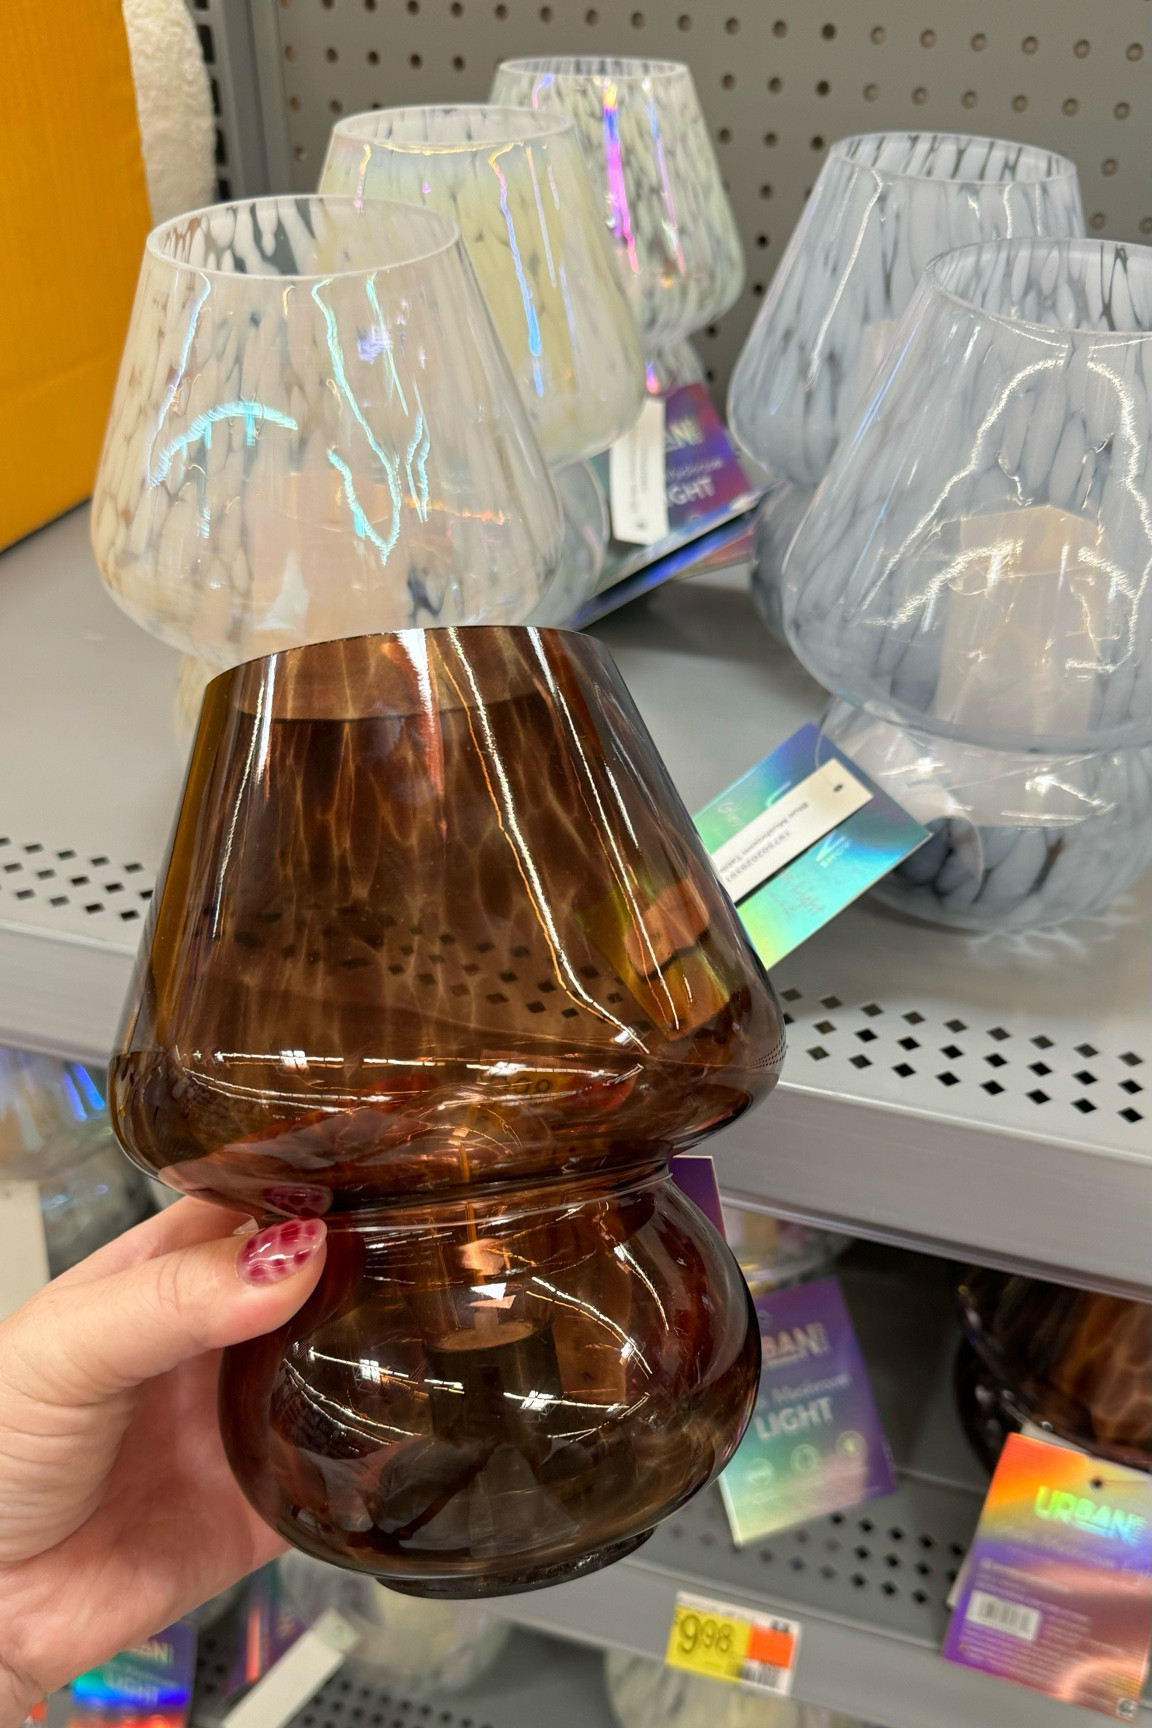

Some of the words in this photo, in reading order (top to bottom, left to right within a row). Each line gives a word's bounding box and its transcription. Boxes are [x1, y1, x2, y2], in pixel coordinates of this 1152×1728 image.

[669, 478, 714, 505] GHT
[742, 819, 788, 855] Mushroom
[761, 1323, 824, 1367] BAN
[755, 1397, 834, 1440] LIGHT
[1035, 1486, 1134, 1541] URBAN
